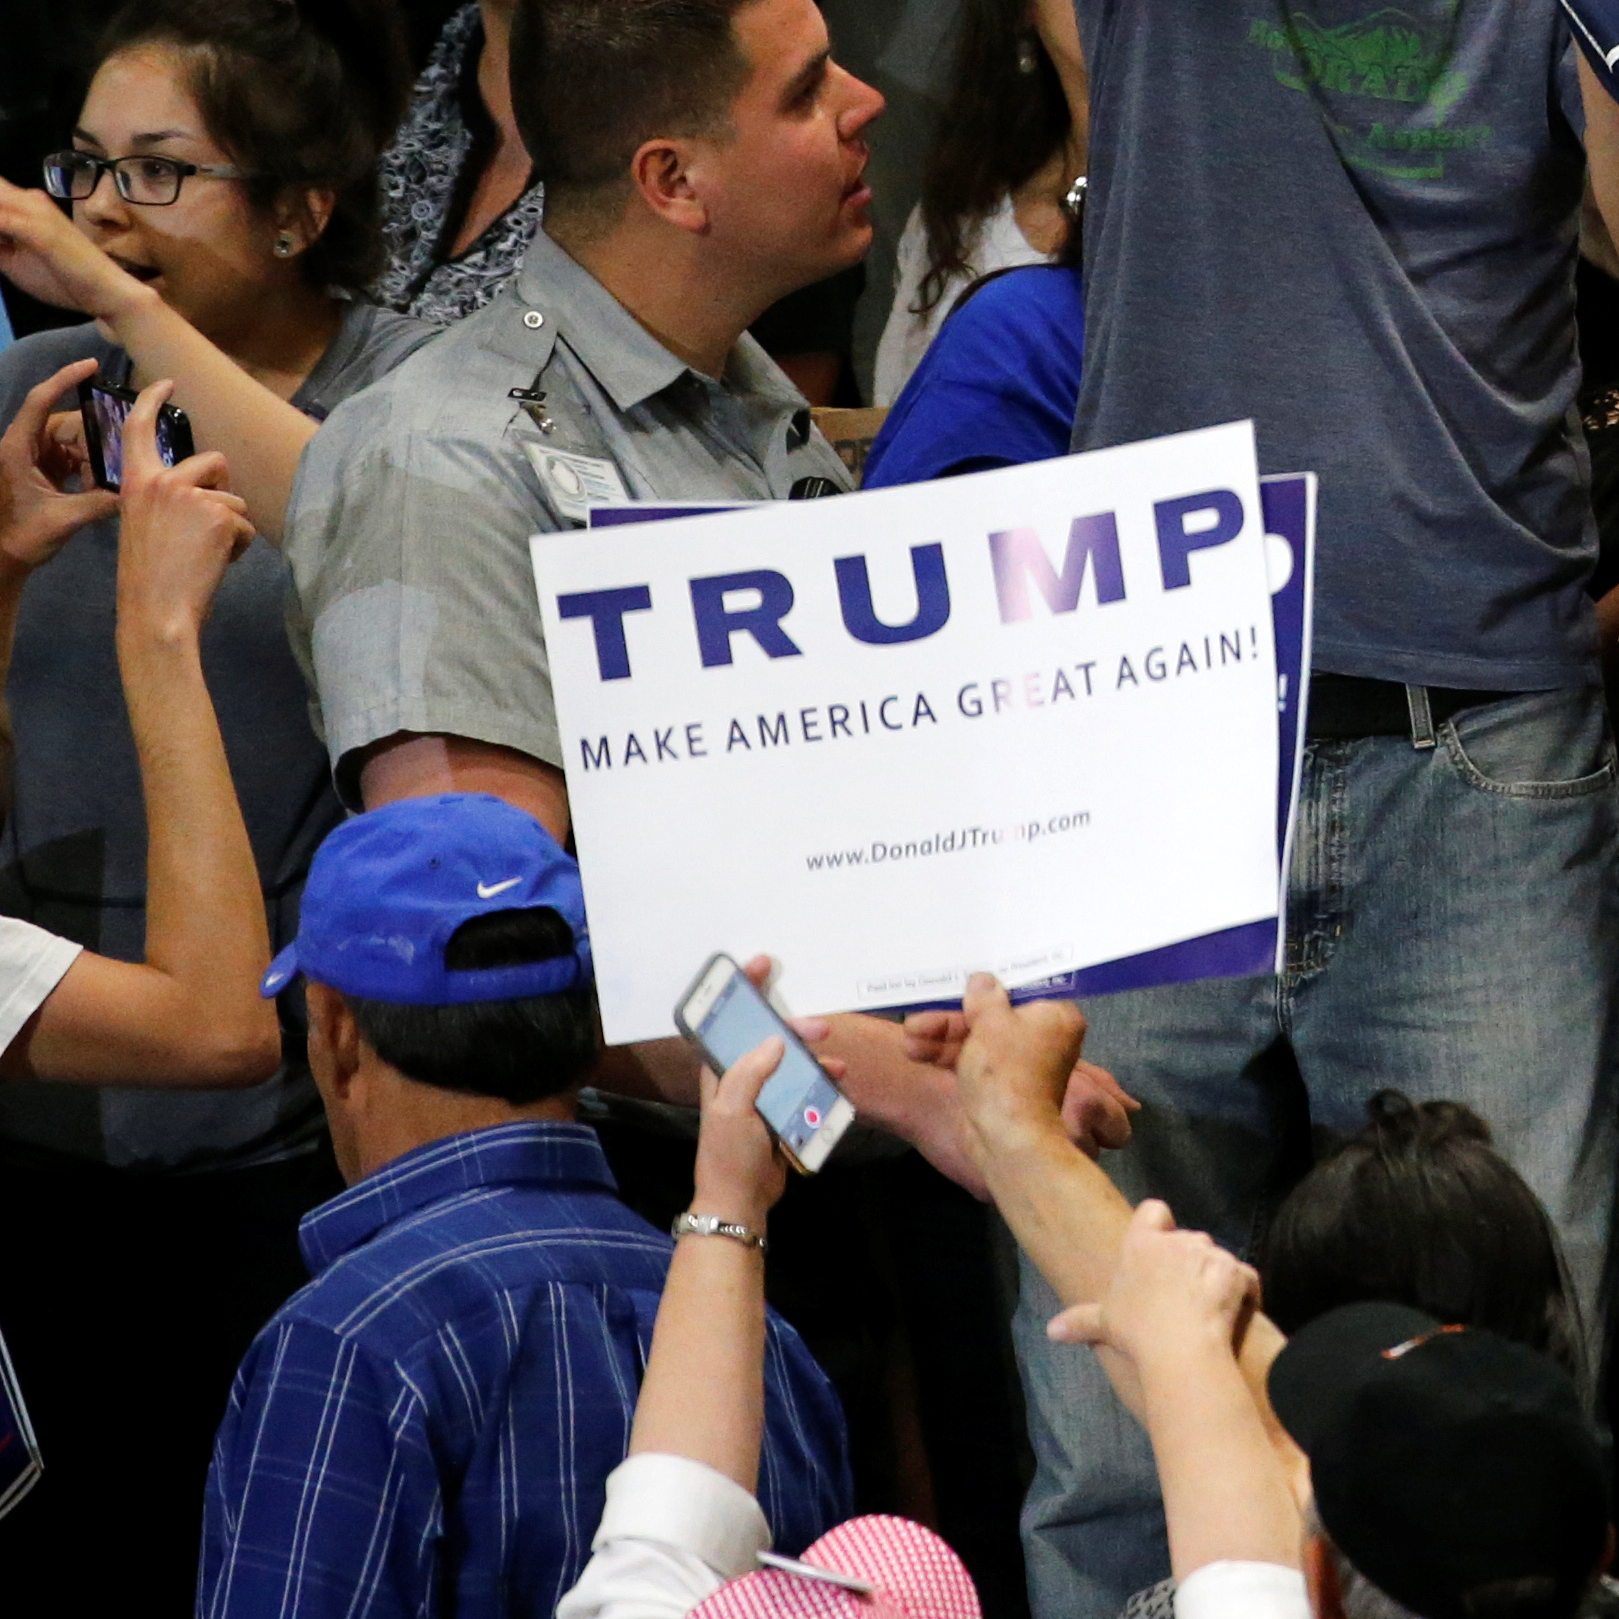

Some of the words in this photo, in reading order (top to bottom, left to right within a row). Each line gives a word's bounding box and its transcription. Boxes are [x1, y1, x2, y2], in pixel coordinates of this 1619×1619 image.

[557, 487, 1246, 682] TRUMP
[581, 722, 708, 772] MAKE
[726, 693, 938, 755] AMERICA
[957, 661, 1098, 718] GREAT
[1116, 625, 1260, 691] AGAIN!
